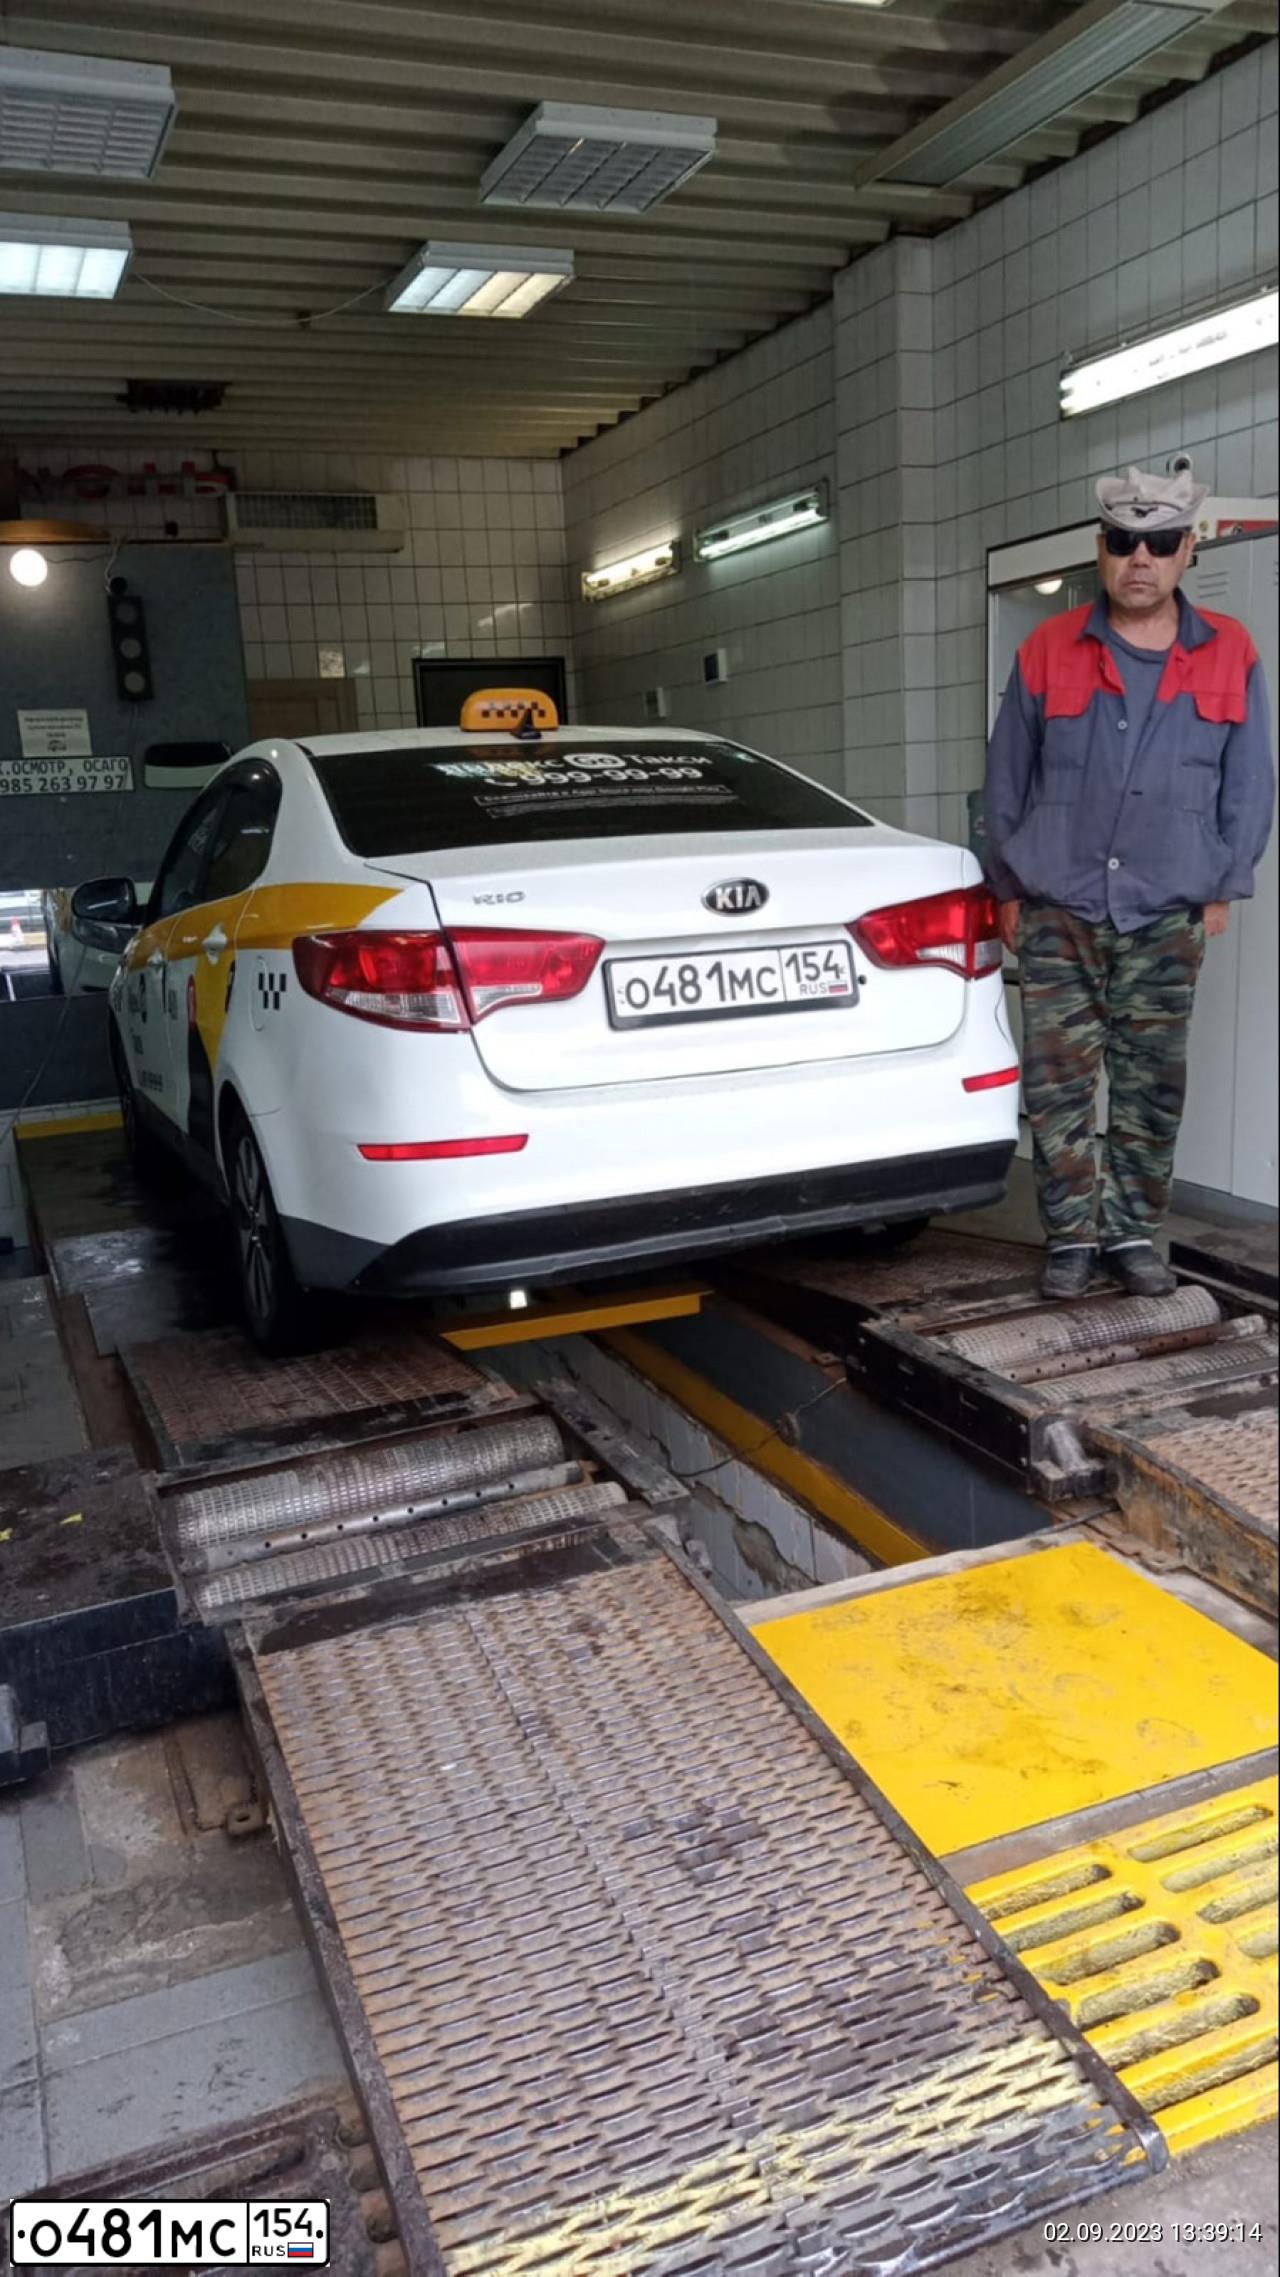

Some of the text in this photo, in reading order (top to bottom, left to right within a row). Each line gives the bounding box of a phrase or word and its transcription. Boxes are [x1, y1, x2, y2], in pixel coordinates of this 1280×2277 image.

[83, 758, 129, 772] ОСАГО
[0, 775, 125, 793] 985 263 97 97
[521, 767, 703, 786] 999-99-99
[716, 885, 765, 910] KIA
[785, 949, 841, 983] 154
[800, 982, 828, 995] RUS
